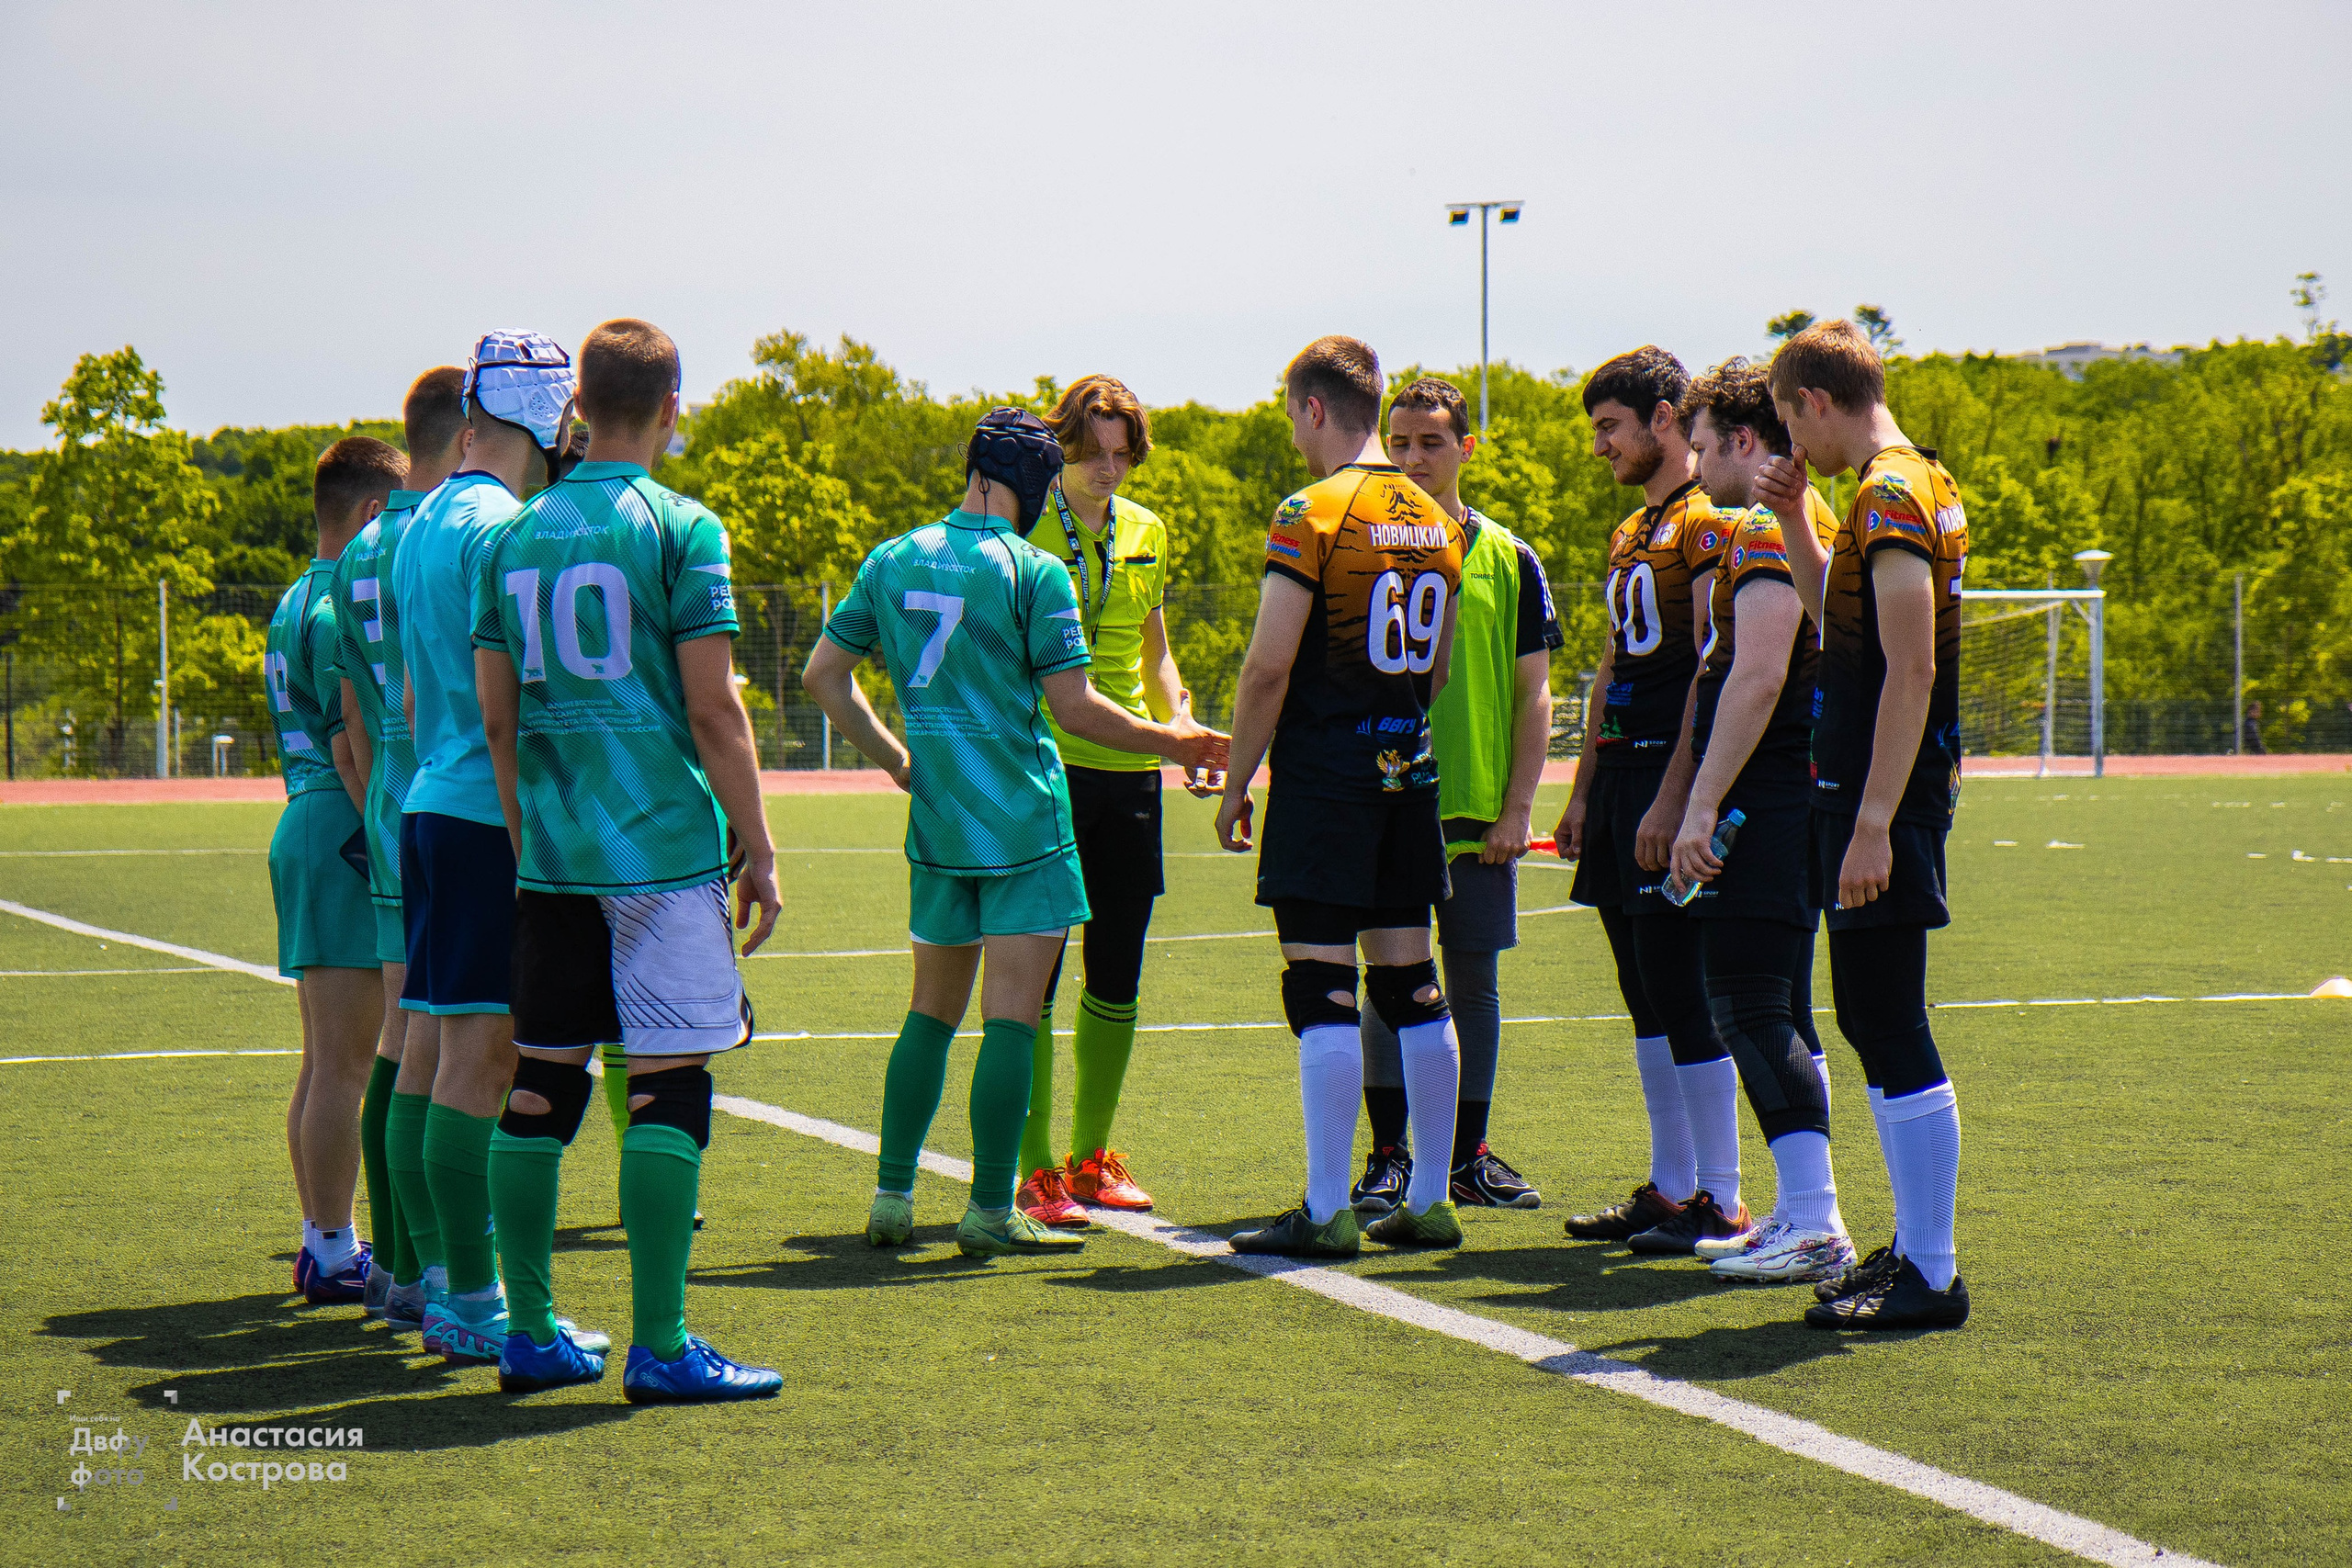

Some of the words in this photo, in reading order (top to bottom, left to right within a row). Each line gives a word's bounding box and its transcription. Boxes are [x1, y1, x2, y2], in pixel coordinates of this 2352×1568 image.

[1370, 522, 1449, 549] НОВИЦКИЙ
[503, 562, 633, 683] 10
[904, 591, 965, 688] 7
[1368, 570, 1449, 673] 69
